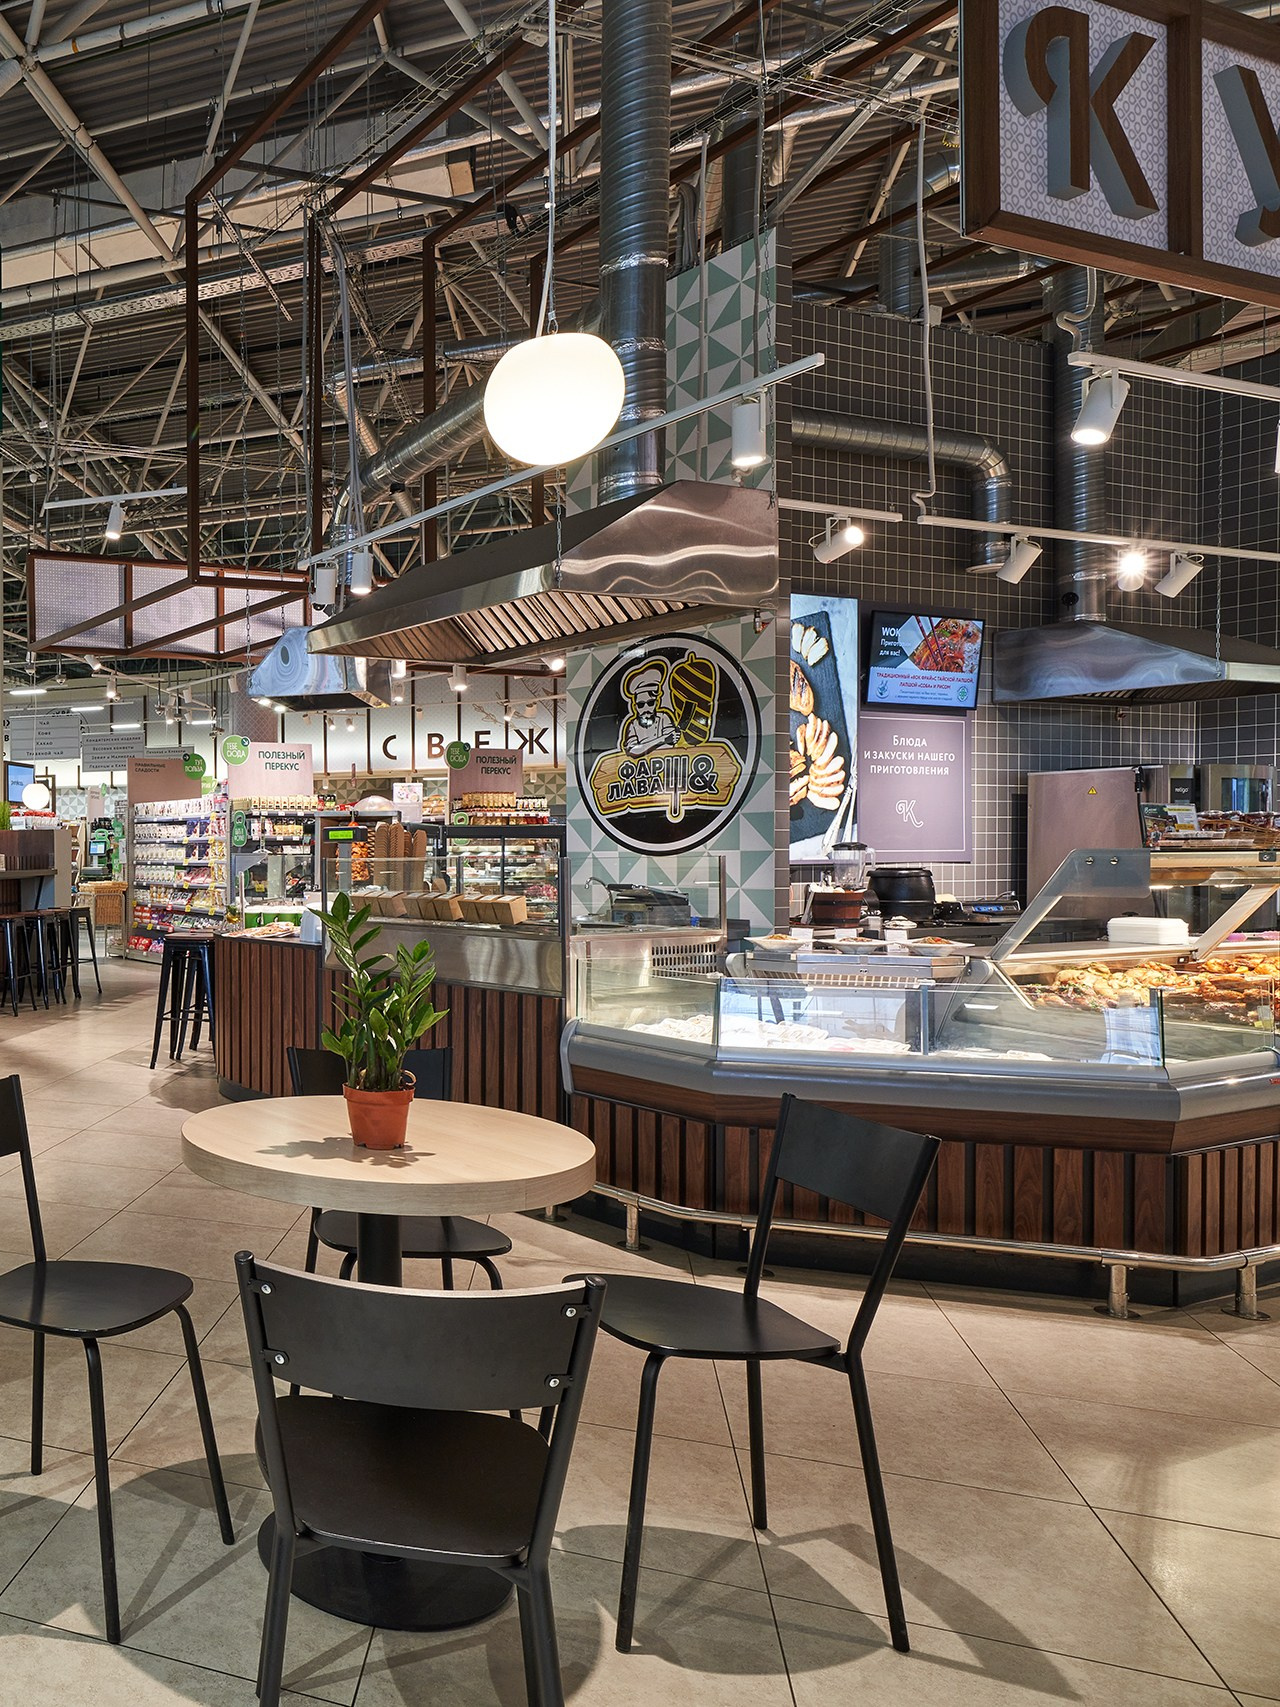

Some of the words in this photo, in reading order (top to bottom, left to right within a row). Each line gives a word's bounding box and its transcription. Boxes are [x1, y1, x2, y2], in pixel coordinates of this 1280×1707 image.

[893, 735, 927, 747] БЛЮДА
[258, 750, 306, 760] ПОЛЕЗНЫЙ
[476, 755, 517, 765] ПОЛЕЗНЫЙ
[864, 751, 871, 759] И
[872, 751, 915, 760] ЗАКУСКИ
[917, 753, 956, 762] НАШЕГО
[265, 762, 300, 771] ПЕРЕКУС
[481, 767, 511, 775] ПЕРЕКУС
[870, 765, 950, 776] ПРИГОТОВЛЕНИЯ
